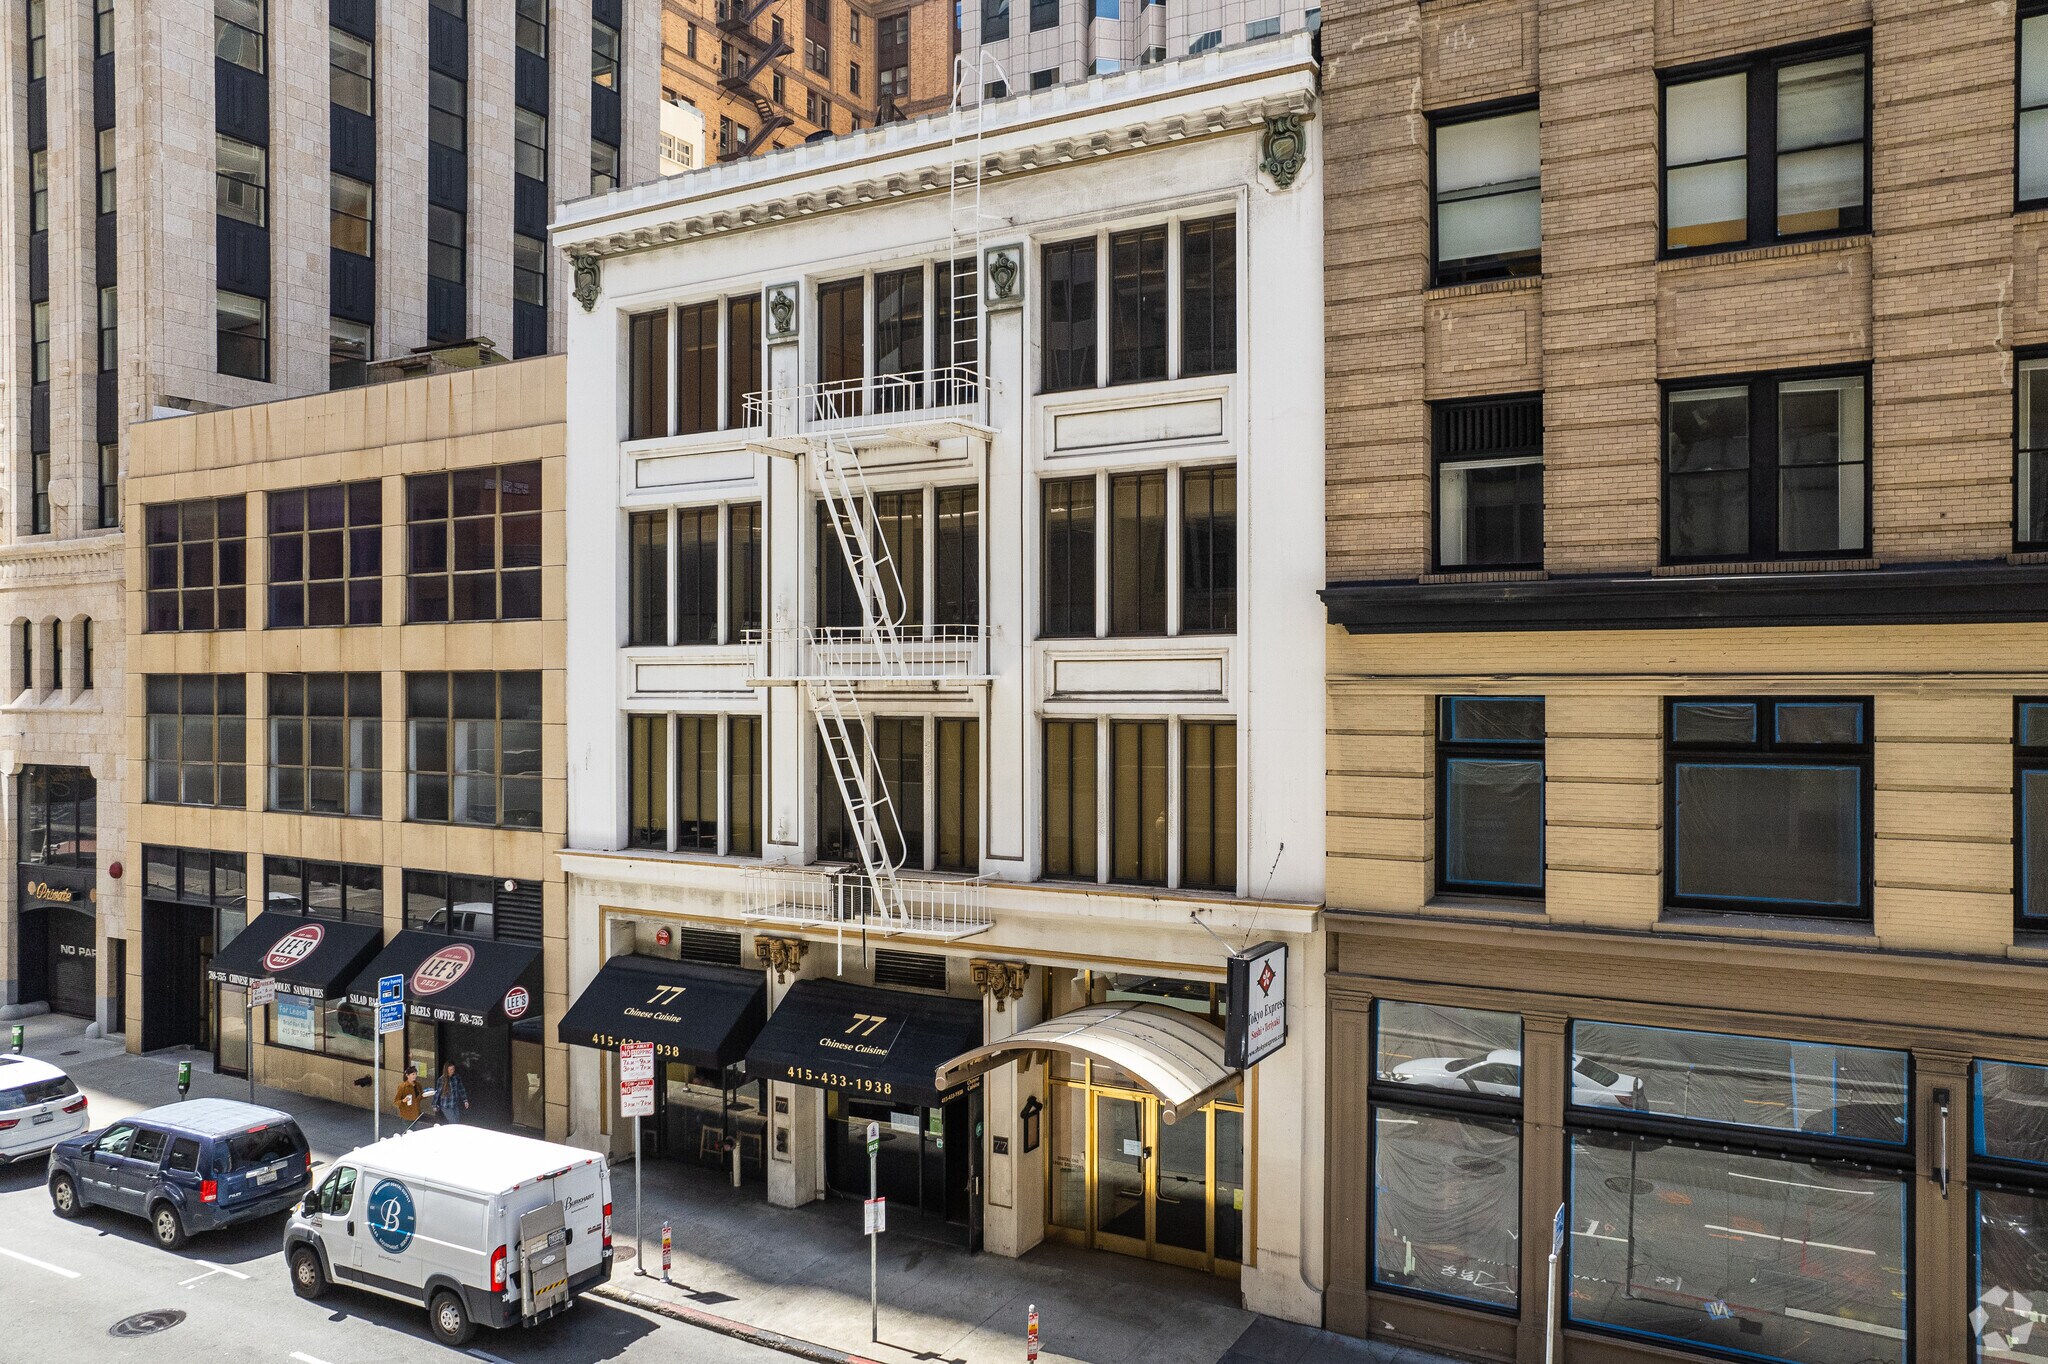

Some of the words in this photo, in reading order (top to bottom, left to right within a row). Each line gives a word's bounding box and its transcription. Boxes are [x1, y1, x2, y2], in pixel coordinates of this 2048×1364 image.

[60, 944, 75, 955] NO
[275, 937, 314, 956] LEE'S
[272, 956, 290, 964] DELI
[421, 959, 464, 980] LEE'S
[229, 974, 249, 986] CHINESE
[274, 981, 291, 993] OODLES
[293, 985, 324, 999] SANDWICHES
[420, 979, 439, 987] DELI
[506, 994, 527, 1009] LEE'S
[646, 984, 687, 1006] 77
[279, 1005, 289, 1014] For
[289, 1008, 306, 1017] Lease
[350, 993, 368, 1006] SALAD
[410, 1004, 431, 1018] BAGELS
[433, 1008, 456, 1022] COFFEE
[623, 1007, 653, 1019] Chinese
[653, 1011, 682, 1023] Cuisine
[1248, 1009, 1264, 1026] Tokyo
[1264, 999, 1285, 1018] Express
[845, 1013, 888, 1037] 77
[1251, 1027, 1262, 1040] Sushi
[1264, 1016, 1281, 1032] Teriyaki
[621, 1049, 631, 1058] NO
[819, 1037, 853, 1051] Chinese
[854, 1044, 888, 1056] Cuisine
[787, 1066, 892, 1095] 415-433-1938
[622, 1086, 632, 1095] NO
[868, 1142, 879, 1152] BUS
[994, 1140, 1008, 1151] 77
